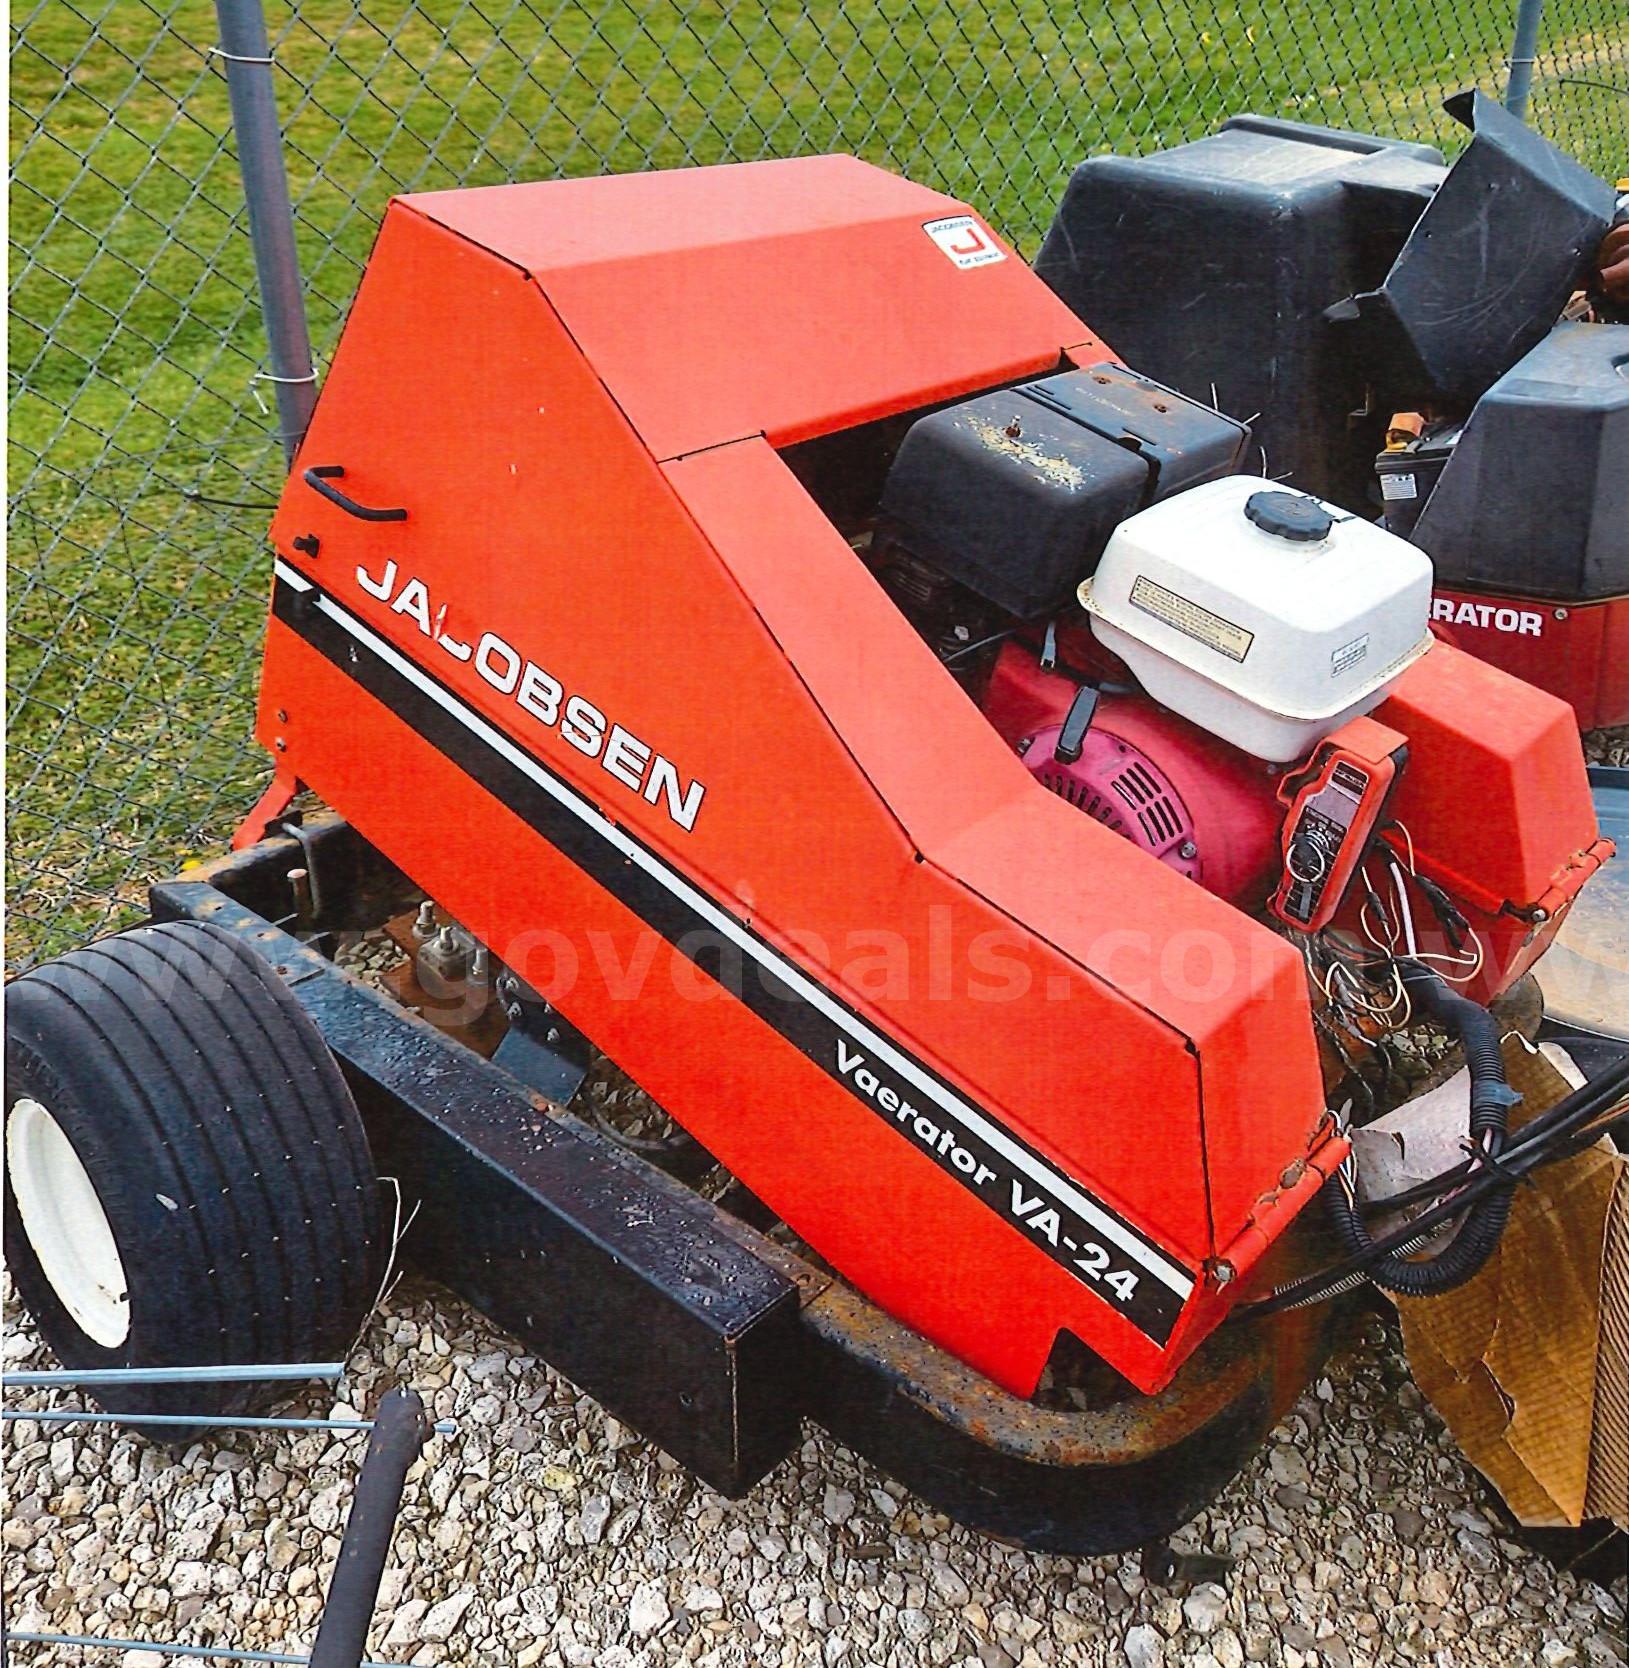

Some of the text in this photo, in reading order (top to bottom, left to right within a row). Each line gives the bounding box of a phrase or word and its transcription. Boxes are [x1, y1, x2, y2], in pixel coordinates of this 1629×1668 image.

[1428, 598, 1543, 637] RATOR
[836, 1039, 1140, 1302] Vaerator VA-24
